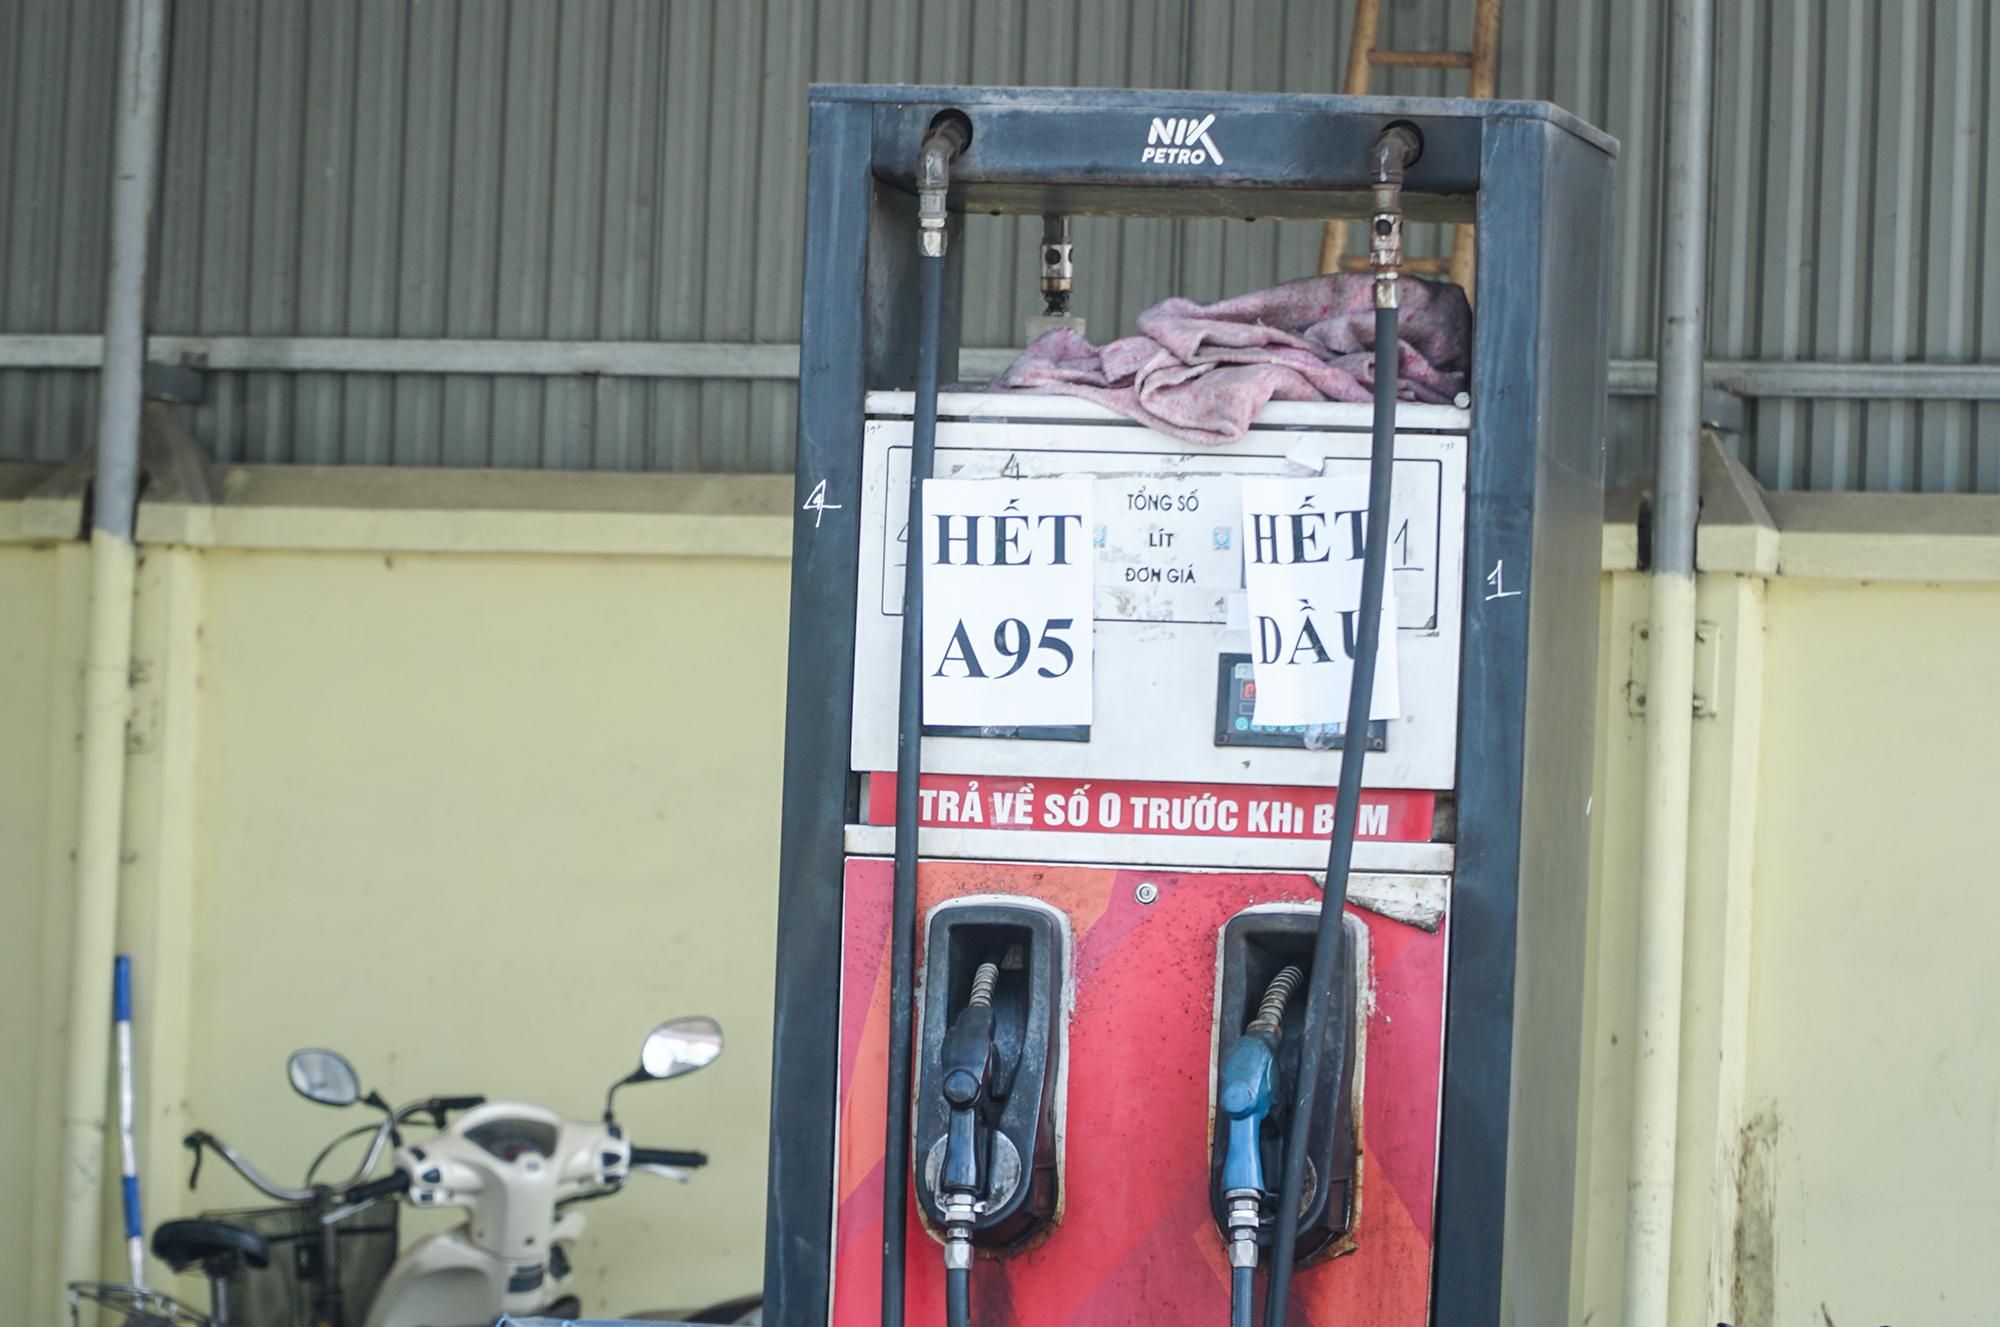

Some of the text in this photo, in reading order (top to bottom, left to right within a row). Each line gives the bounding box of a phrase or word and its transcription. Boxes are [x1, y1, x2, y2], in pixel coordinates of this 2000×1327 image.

[1141, 147, 1206, 165] PETRO
[1147, 113, 1224, 166] NIK
[803, 479, 842, 528] 4
[1127, 485, 1199, 512] TỔNG SỐ
[931, 498, 1082, 566] HẾT
[1149, 527, 1174, 547] LÍT
[1249, 494, 1369, 564] HẾT
[1125, 563, 1196, 583] ĐƠN GIÁ
[1485, 559, 1522, 601] 1
[931, 617, 1074, 680] A95
[919, 780, 984, 823] TRẢ
[993, 782, 1035, 825] VỀ
[1043, 783, 1091, 827] SỐ
[1130, 792, 1238, 833] TRƯỚC
[1313, 803, 1389, 836] BM
